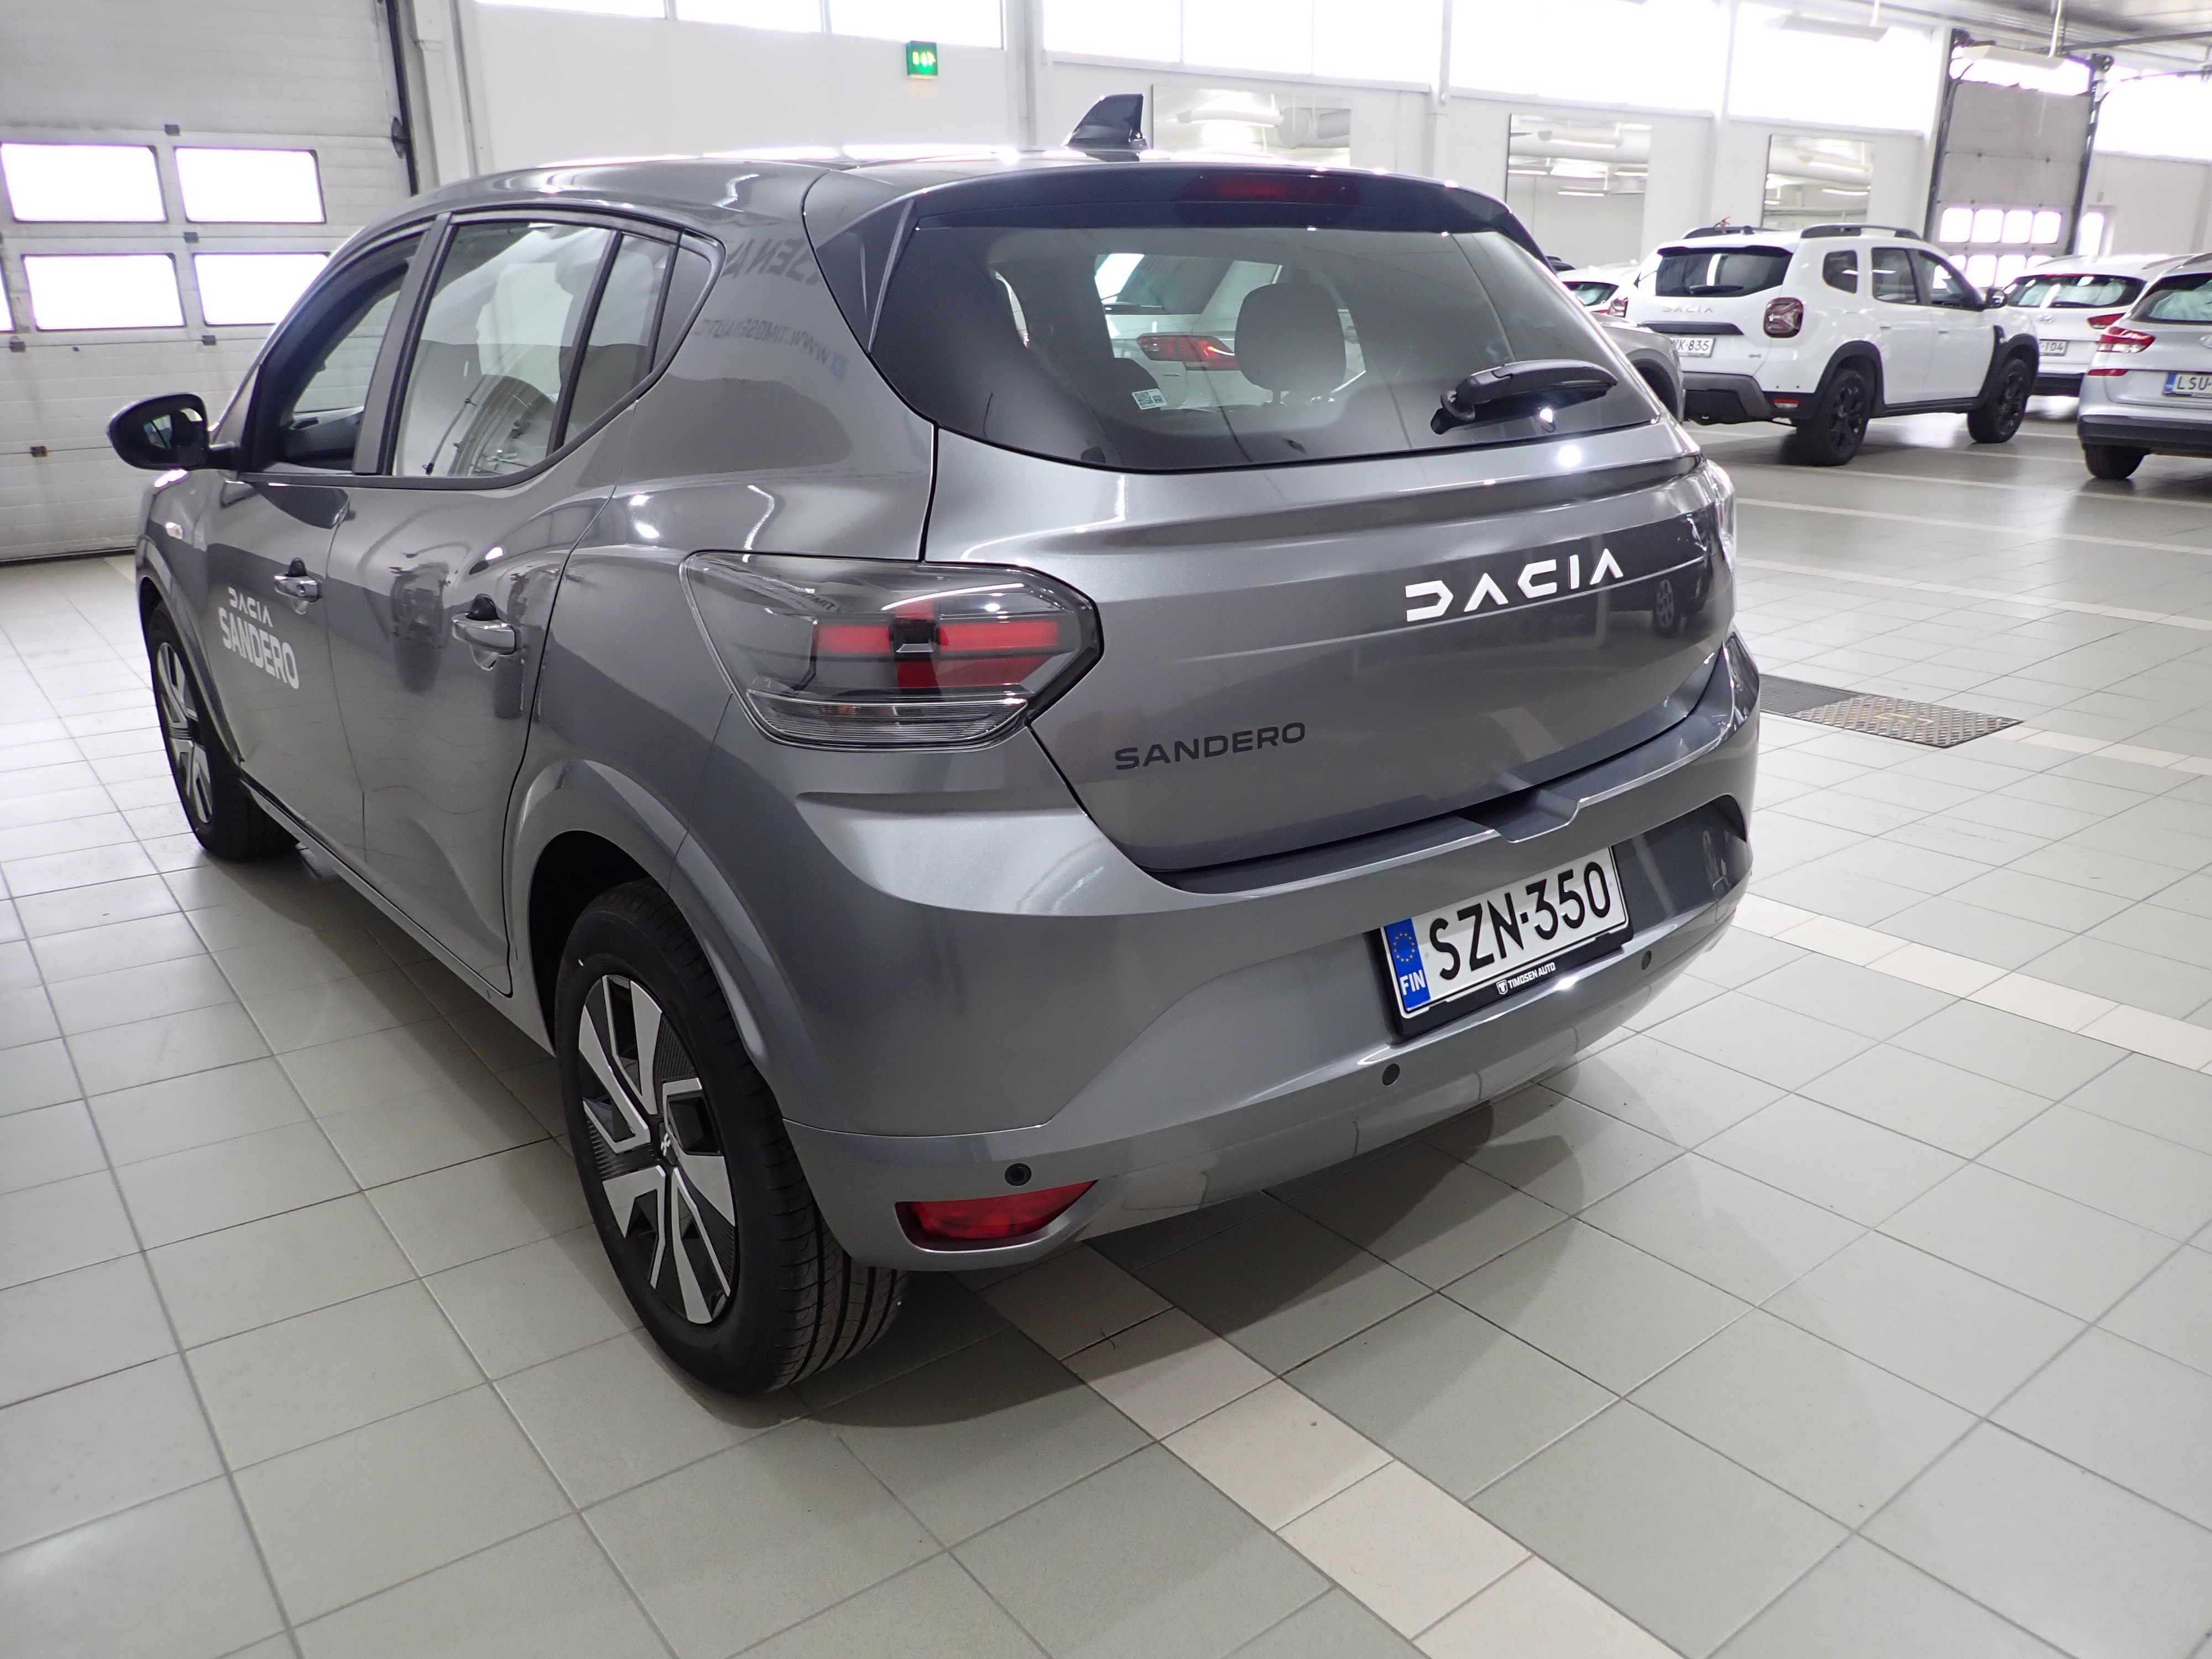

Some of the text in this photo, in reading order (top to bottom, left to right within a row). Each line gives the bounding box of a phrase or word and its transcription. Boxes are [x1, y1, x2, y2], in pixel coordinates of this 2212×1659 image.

[2039, 341, 2063, 351] -104
[227, 586, 273, 628] DACIA
[1406, 548, 1624, 622] DACIA
[218, 607, 299, 690] SANDERO
[1114, 722, 1306, 770] SANDERO
[1428, 861, 1611, 981] SZN-350
[1400, 969, 1427, 995] FIN
[1507, 969, 1538, 989] TIMOSEN
[1537, 962, 1556, 977] AUTO
